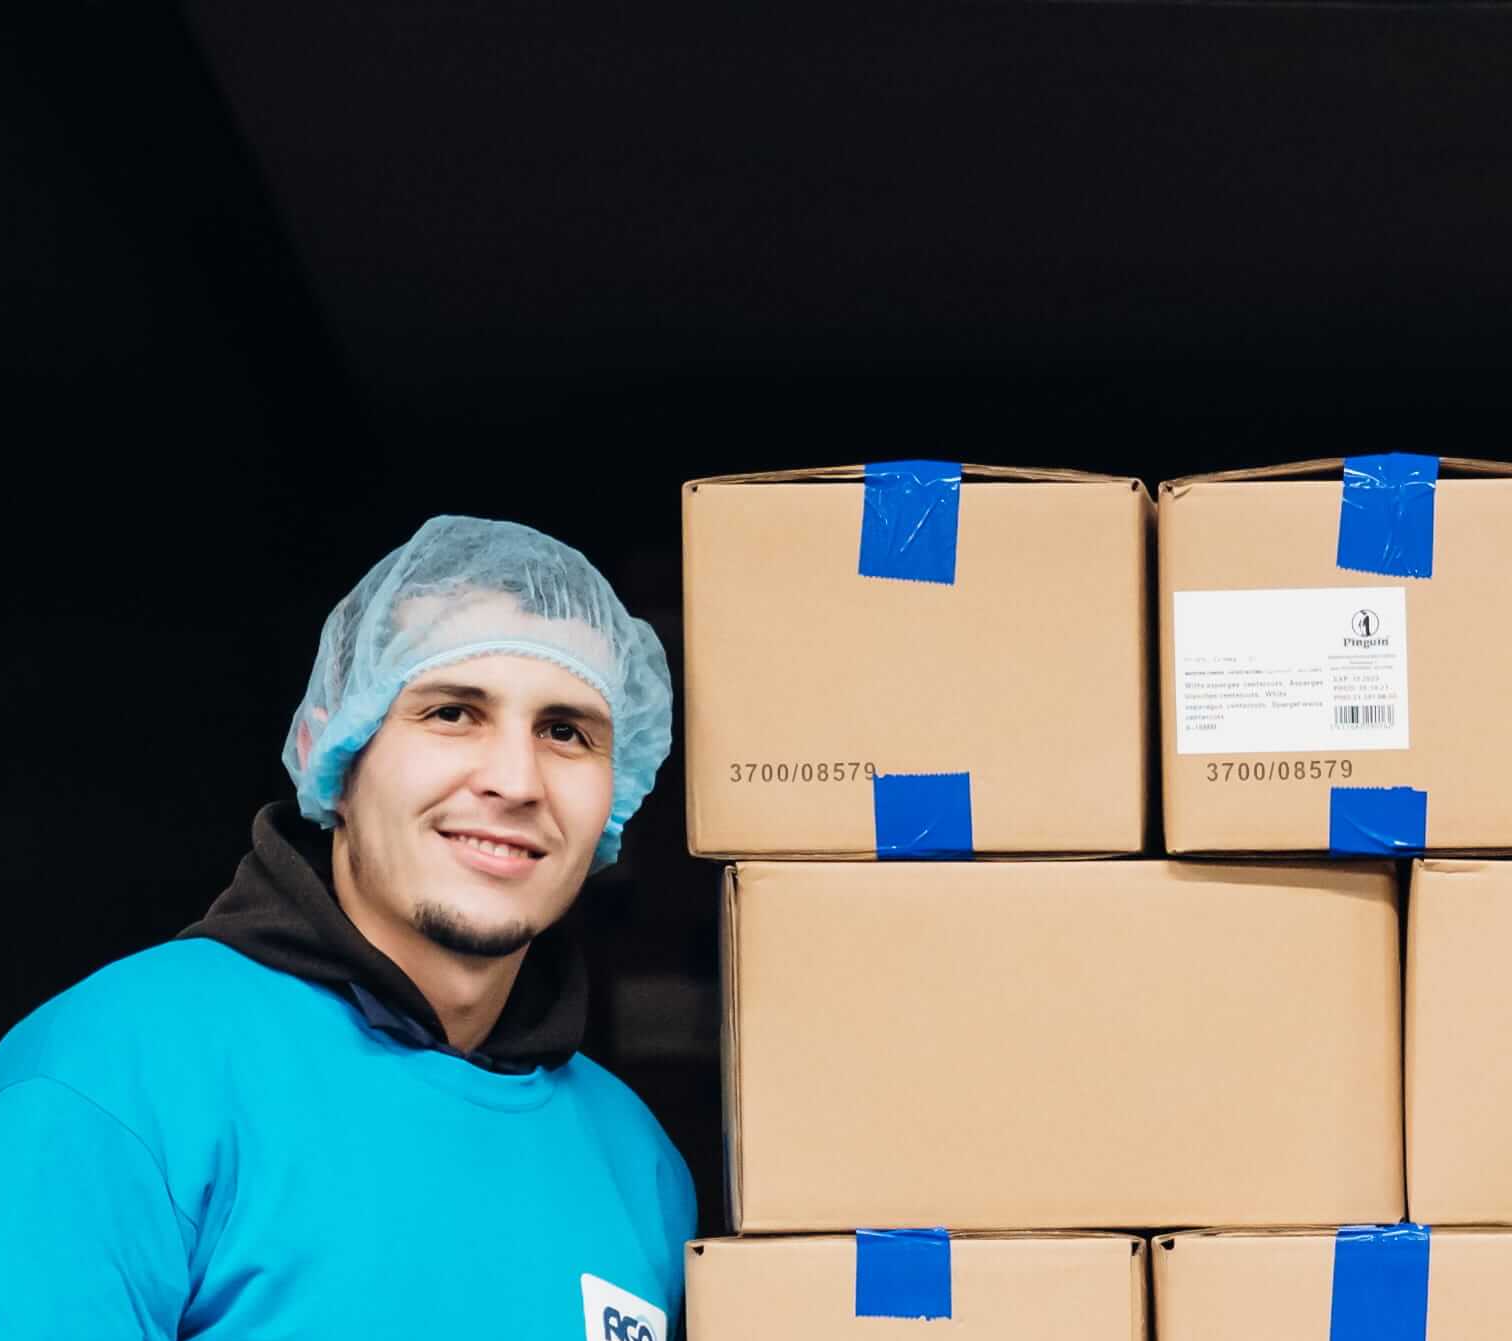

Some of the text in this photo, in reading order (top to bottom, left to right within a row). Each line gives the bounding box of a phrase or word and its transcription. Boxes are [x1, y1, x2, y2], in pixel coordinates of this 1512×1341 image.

[1343, 636, 1389, 649] Pinguin
[729, 761, 878, 783] 3700/08579
[1206, 759, 1353, 783] 3700/08579
